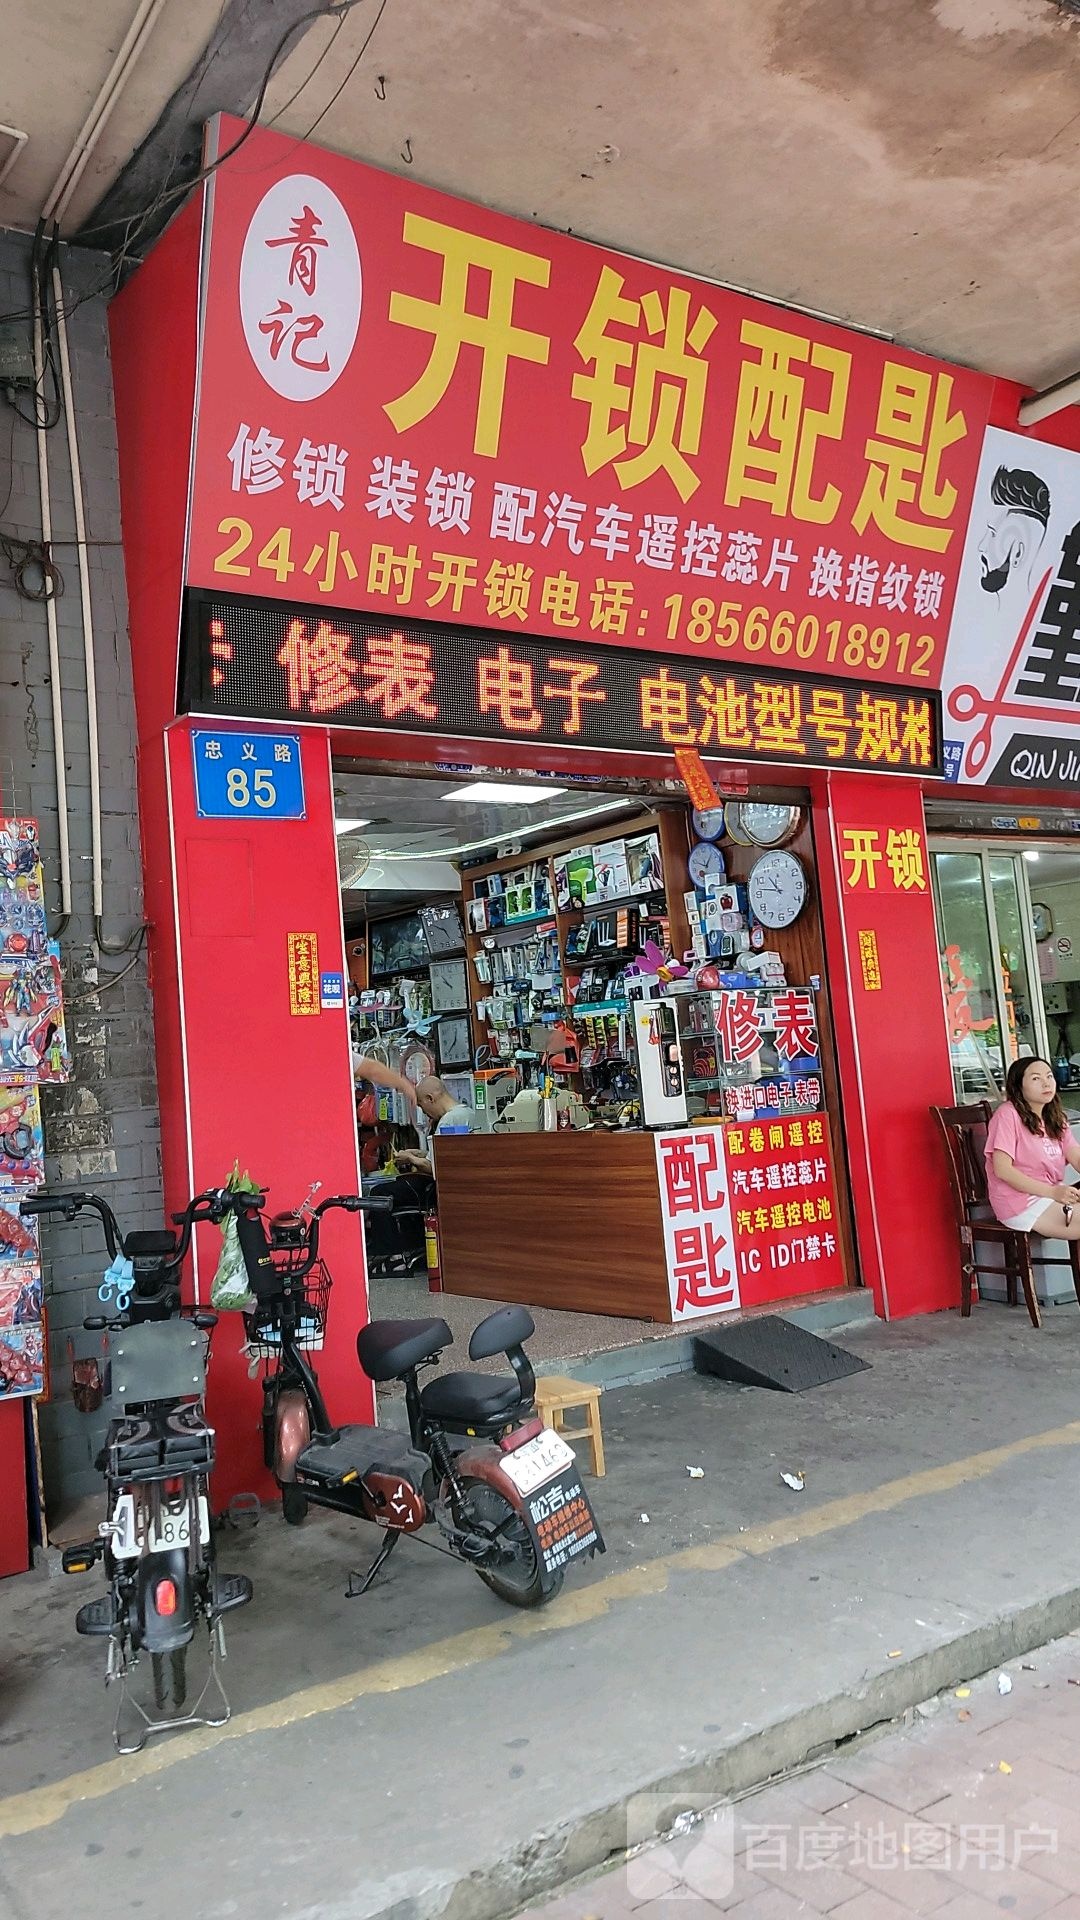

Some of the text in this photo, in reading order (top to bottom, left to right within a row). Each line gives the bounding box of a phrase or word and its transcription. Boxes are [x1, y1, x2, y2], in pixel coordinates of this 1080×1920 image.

[258, 205, 331, 372] 青记
[382, 210, 968, 554] 开锁配匙
[227, 421, 349, 511] 修锁
[364, 455, 476, 537] 装锁
[489, 480, 799, 593] 配汽车遥控蕊片
[807, 546, 946, 621] 换指纹锁
[277, 616, 440, 720] 修表
[475, 647, 607, 735] 电子
[204, 740, 293, 764] 忠义路
[1010, 748, 1058, 780] QIN
[226, 768, 278, 808] 85
[843, 828, 927, 891] 开锁
[715, 989, 819, 1064] 修表
[725, 1077, 821, 1114] 换进口电子表带
[726, 1119, 824, 1156] 配卷闸遥控
[732, 1157, 828, 1196] 汽车遥控蕊片
[660, 1133, 735, 1314] 配匙
[736, 1196, 833, 1237] 汽车遥控电池
[740, 1232, 836, 1275] IC ID门禁卡
[529, 1484, 566, 1525] 松吉
